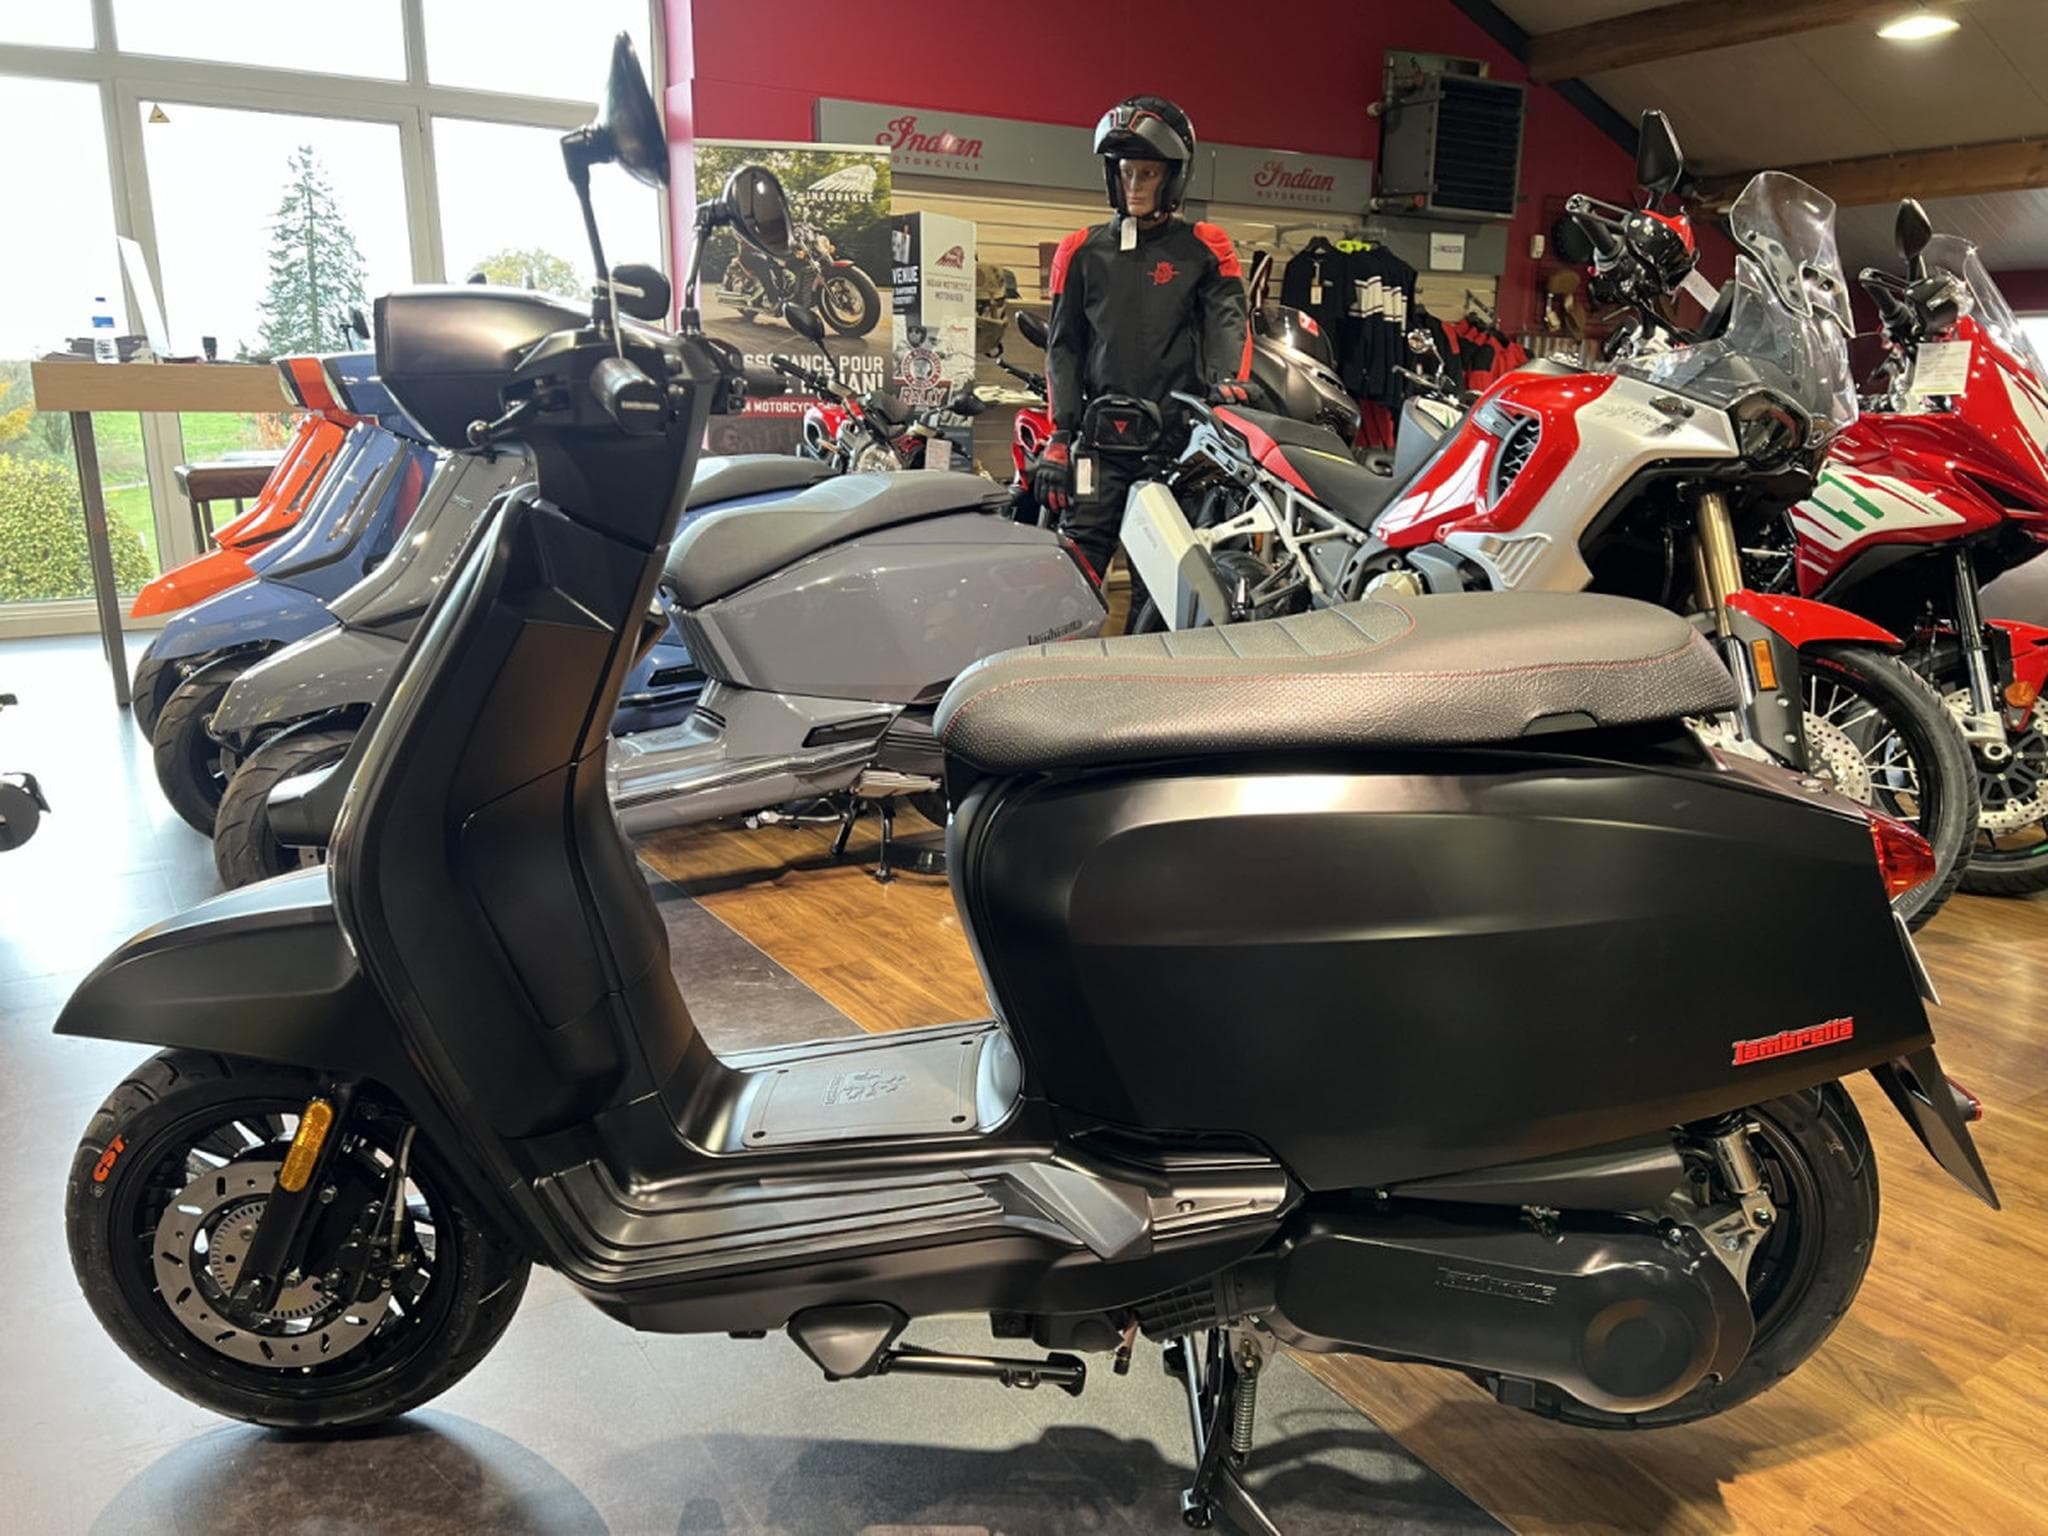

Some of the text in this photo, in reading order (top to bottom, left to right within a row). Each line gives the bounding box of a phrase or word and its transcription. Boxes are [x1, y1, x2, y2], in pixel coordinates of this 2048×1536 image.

[892, 155, 980, 172] OTORCYCLE
[1254, 159, 1335, 192] Indian
[806, 191, 874, 203] INSURANCE
[839, 355, 884, 373] POUR
